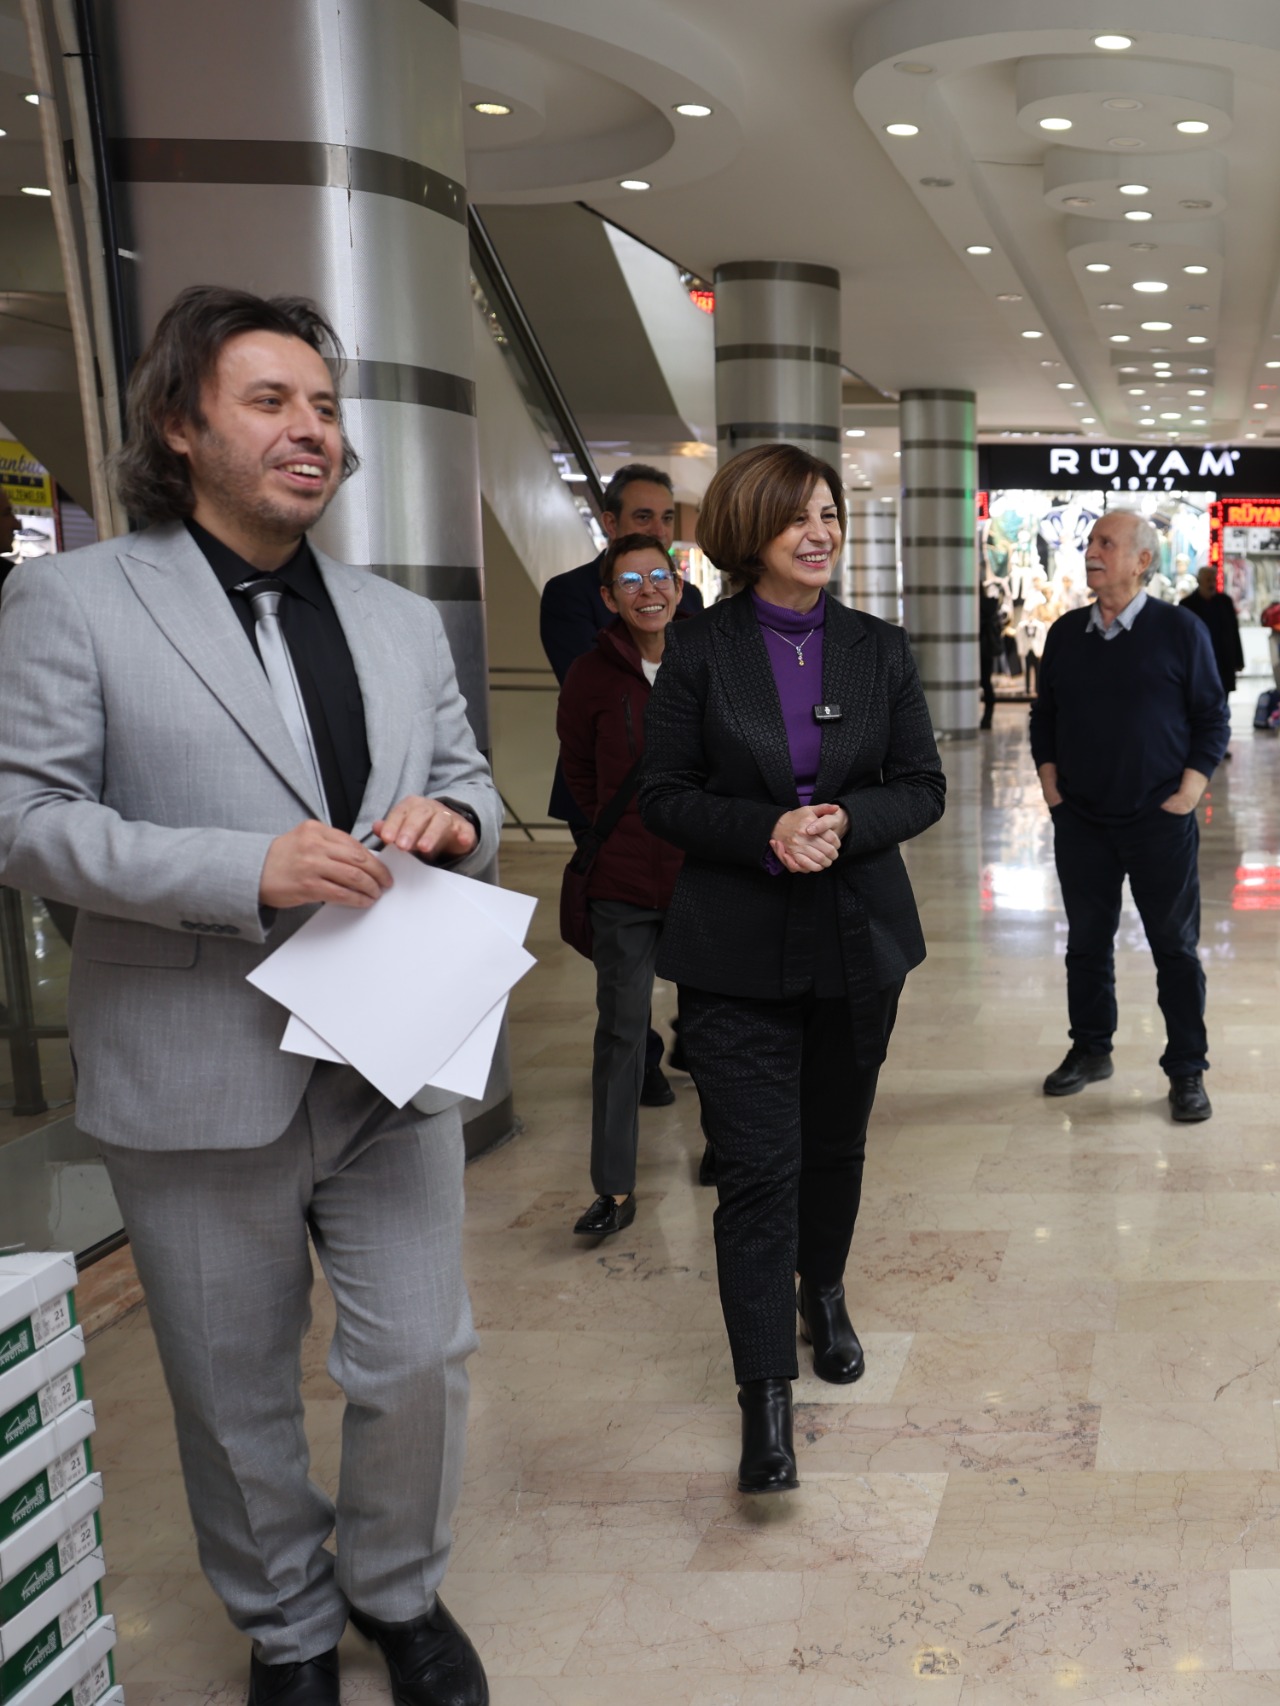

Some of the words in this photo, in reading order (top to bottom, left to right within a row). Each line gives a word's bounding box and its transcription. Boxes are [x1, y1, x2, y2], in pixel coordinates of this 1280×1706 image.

[1050, 448, 1235, 476] RÜYAM
[1111, 476, 1175, 491] 1977
[54, 1308, 64, 1321] 21
[62, 1382, 71, 1396] 22
[71, 1457, 81, 1471] 21
[81, 1528, 91, 1542] 22
[82, 1600, 92, 1614] 21
[95, 1670, 105, 1685] 24
